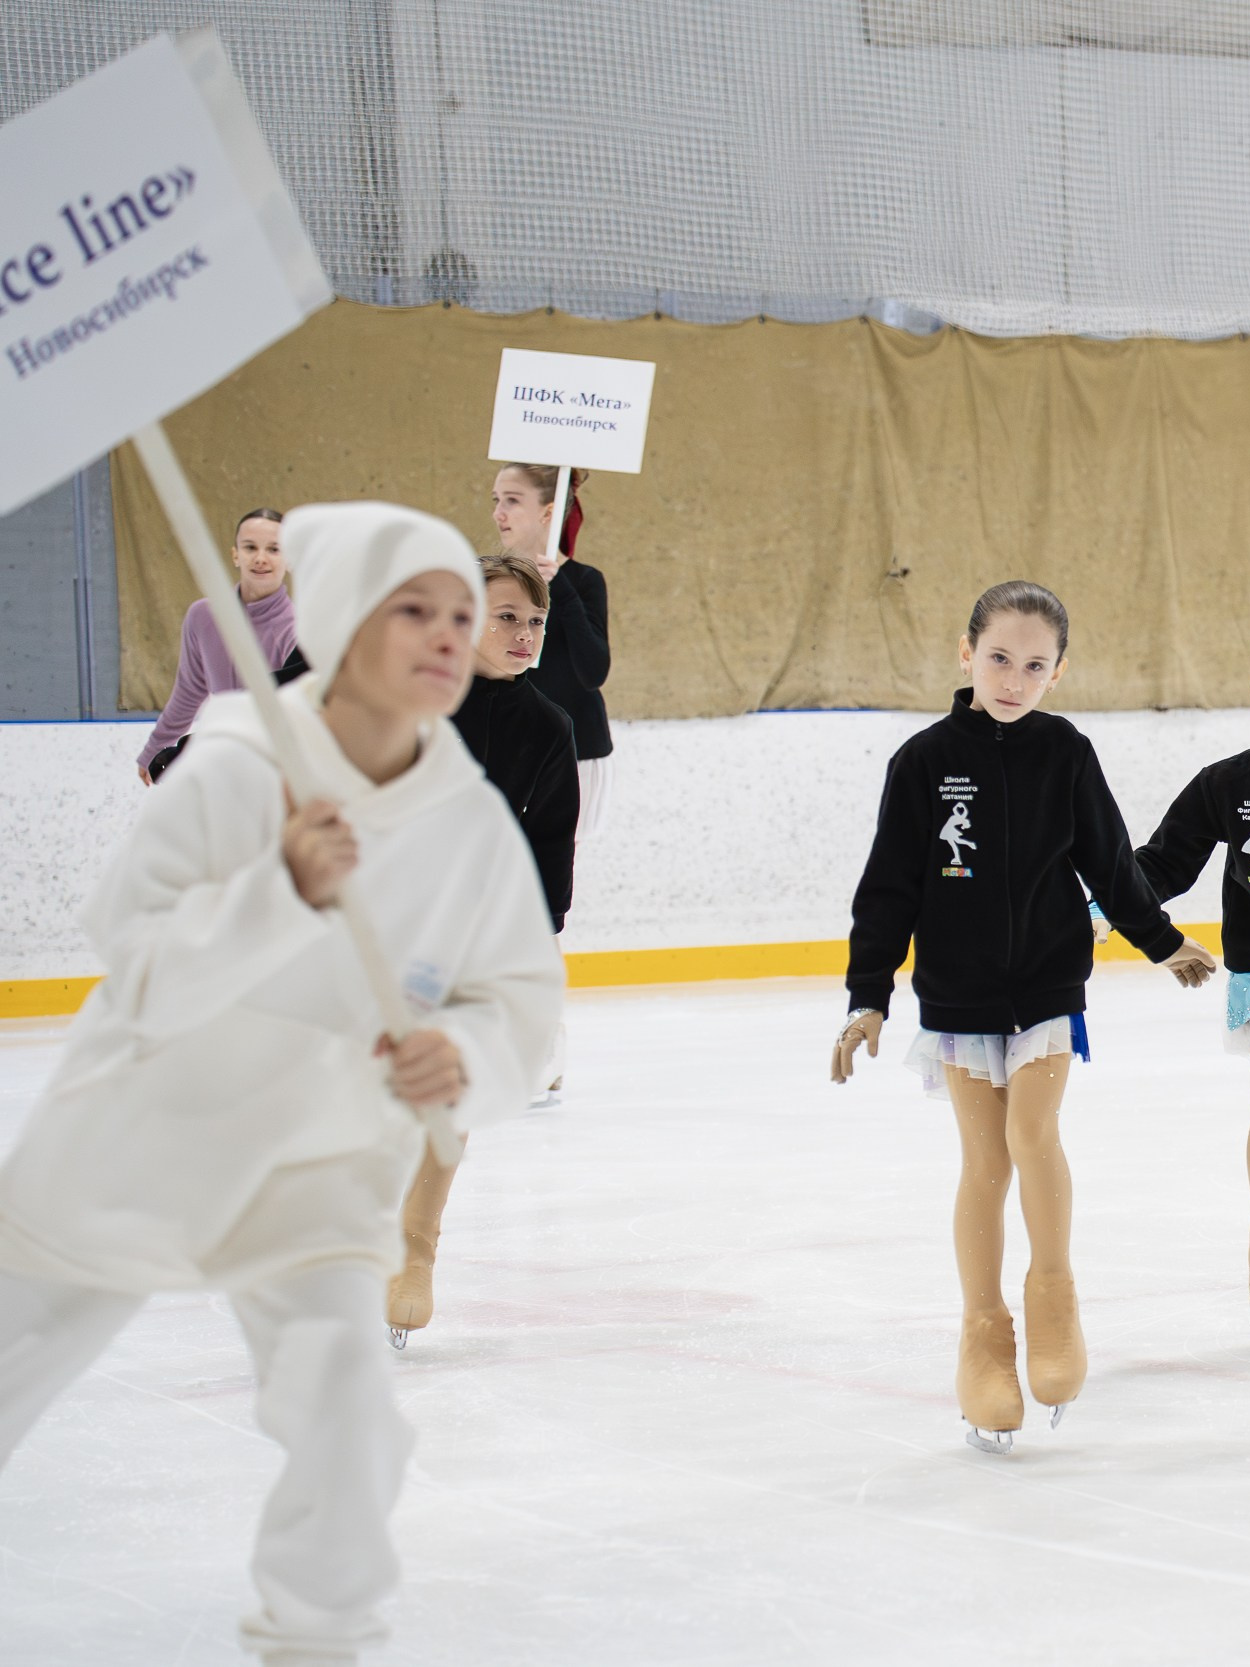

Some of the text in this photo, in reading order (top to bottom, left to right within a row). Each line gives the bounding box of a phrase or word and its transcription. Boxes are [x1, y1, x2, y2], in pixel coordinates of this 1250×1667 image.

[0, 165, 197, 316] ce line»
[7, 245, 209, 379] Новосибирск
[513, 386, 632, 410] ШФК «Мега»
[522, 410, 618, 432] Новосибирск
